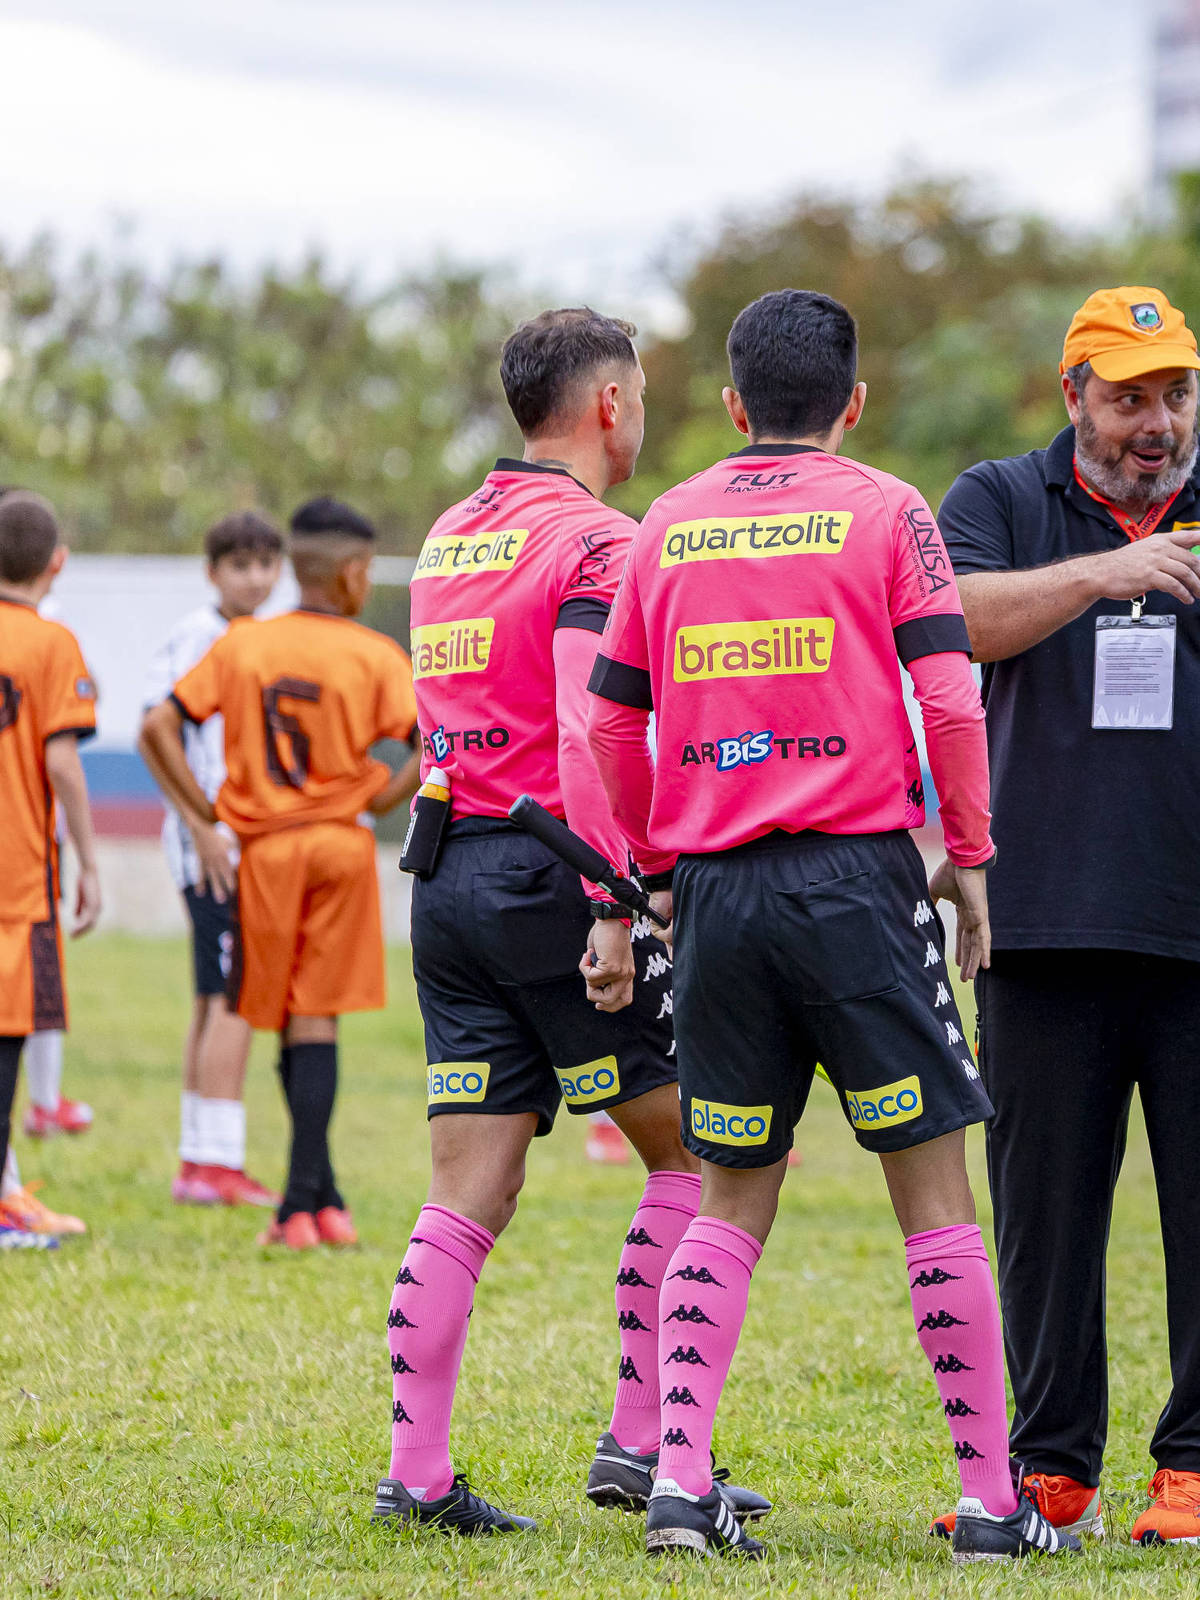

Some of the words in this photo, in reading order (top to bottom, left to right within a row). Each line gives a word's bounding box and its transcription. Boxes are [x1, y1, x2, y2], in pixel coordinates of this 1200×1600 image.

[729, 472, 798, 486] FUT
[418, 535, 518, 570] uartzolit
[667, 514, 841, 560] quartzolit
[411, 628, 487, 674] rasilit
[679, 627, 828, 675] brasilit
[262, 677, 321, 788] 6
[427, 1067, 483, 1095] laco
[560, 1068, 615, 1097] aco
[693, 1103, 766, 1138] placo
[847, 1089, 918, 1126] placo
